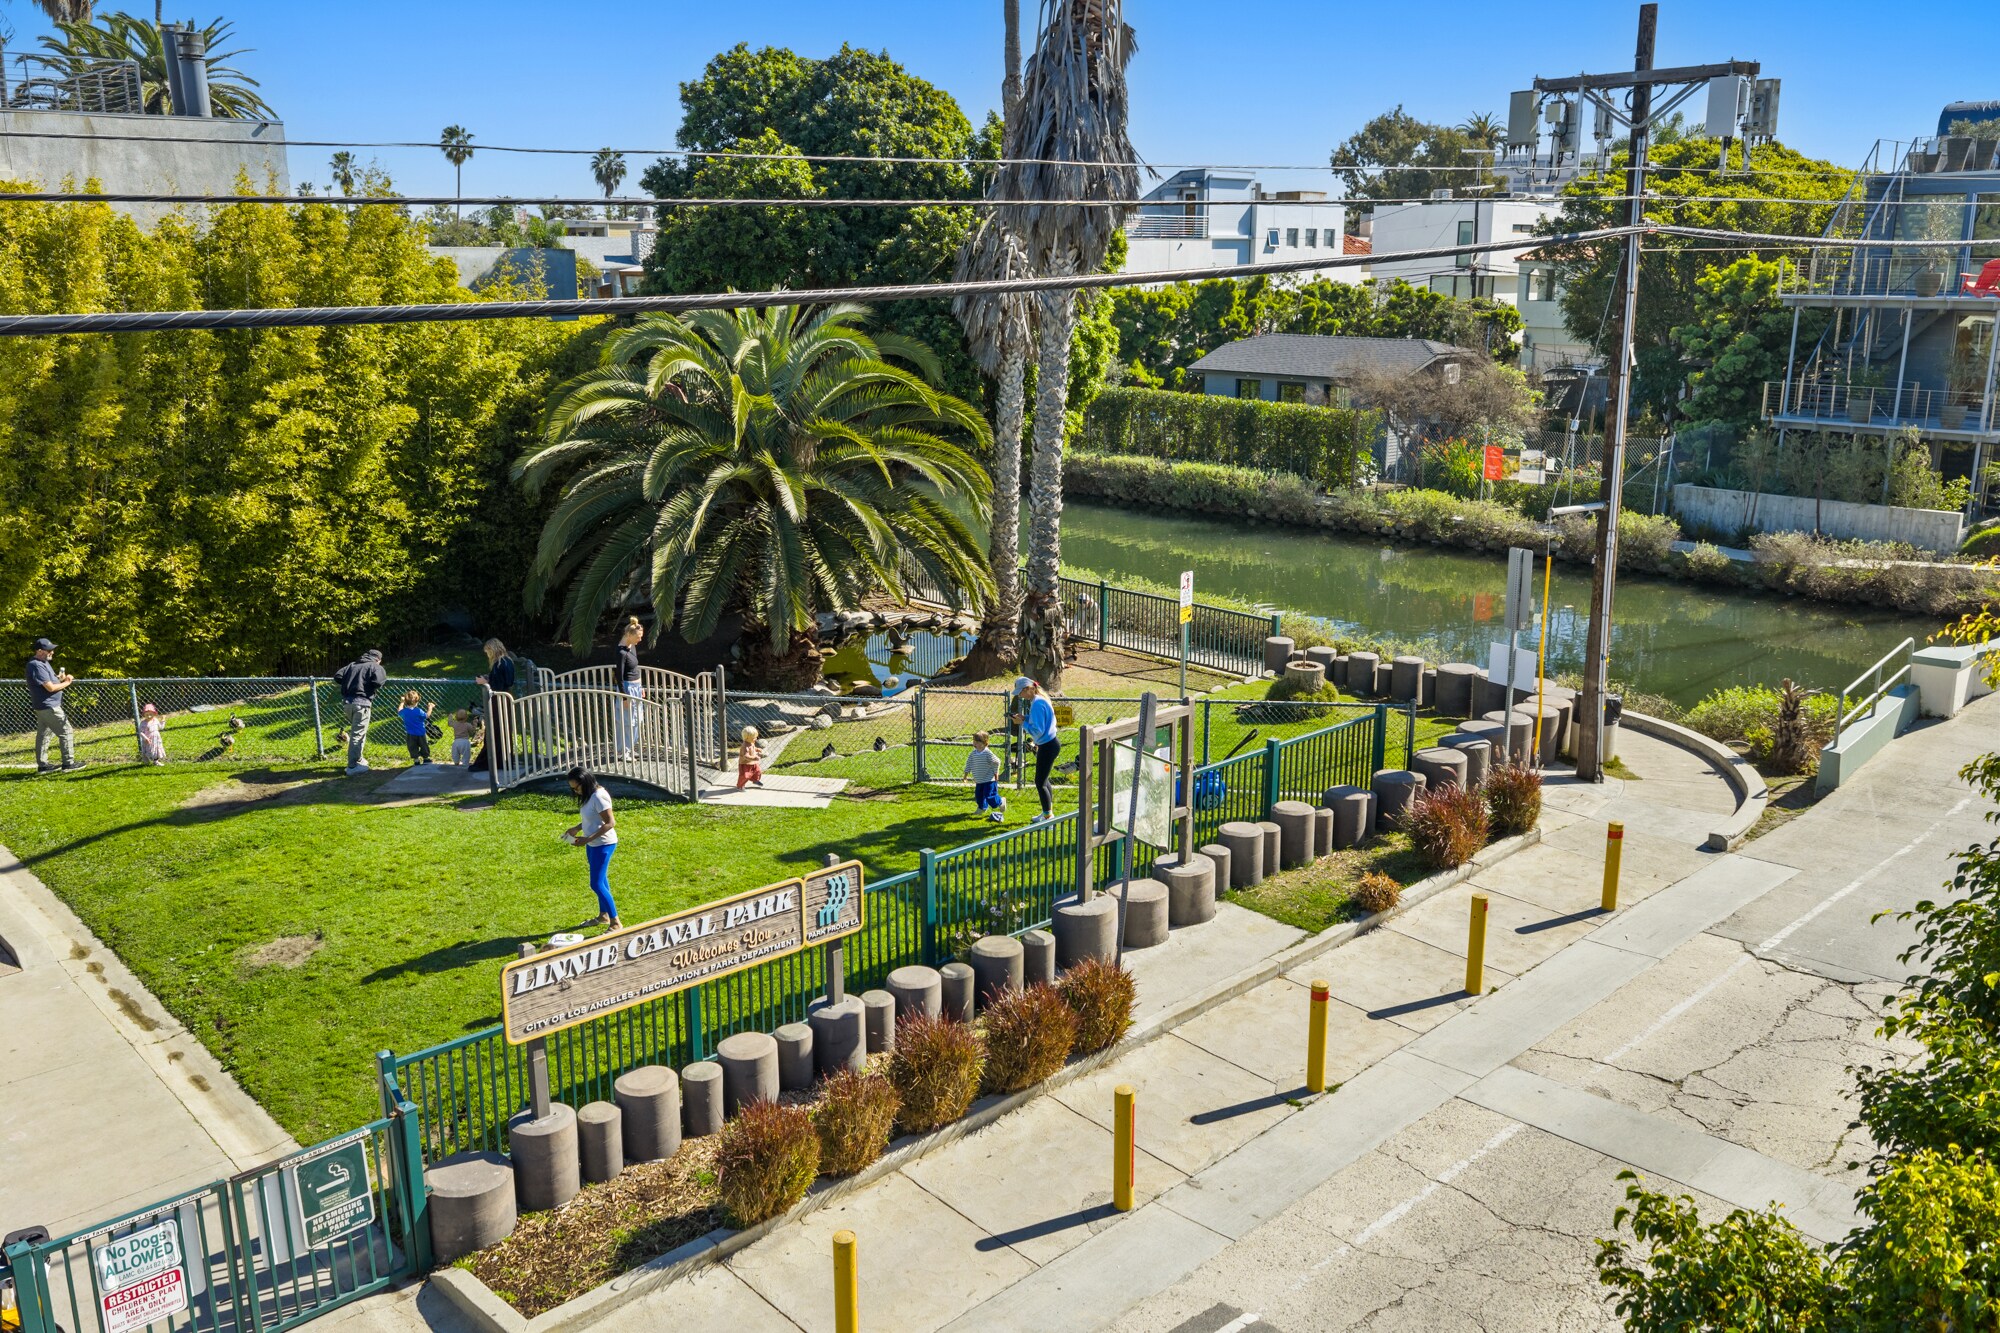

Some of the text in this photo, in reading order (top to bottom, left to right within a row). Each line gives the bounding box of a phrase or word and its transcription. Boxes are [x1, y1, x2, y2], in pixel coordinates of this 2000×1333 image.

[514, 889, 796, 994] LINNIE CANAL PARK
[808, 918, 860, 940] PARK PROUD LA
[673, 939, 740, 968] Welcomes
[526, 1018, 550, 1032] CITY
[552, 1013, 566, 1023] OF
[568, 1006, 587, 1018] LOS
[590, 990, 634, 1011] ANGELES
[642, 968, 701, 994] RECREATION
[711, 956, 740, 972] PARKS
[742, 937, 797, 962] DEPARTMENT
[283, 1132, 365, 1166] CLOSE AND LATCH GATE
[312, 1200, 362, 1226] NO SMOKING
[312, 1210, 354, 1234] ANYWHERE
[356, 1204, 365, 1214] IN
[330, 1218, 350, 1232] PARK
[105, 1242, 174, 1280] ALLOWED
[106, 1231, 166, 1261] No Dogs
[108, 1272, 176, 1308] RESTRICTED
[112, 1285, 177, 1316] CHILDREN'S PLAY
[125, 1306, 145, 1318] AREA
[148, 1296, 167, 1309] ONLY
[126, 1315, 142, 1324] WITHOUT
[143, 1308, 160, 1318] CHILDREN
[161, 1298, 182, 1311] PROHIBITED
